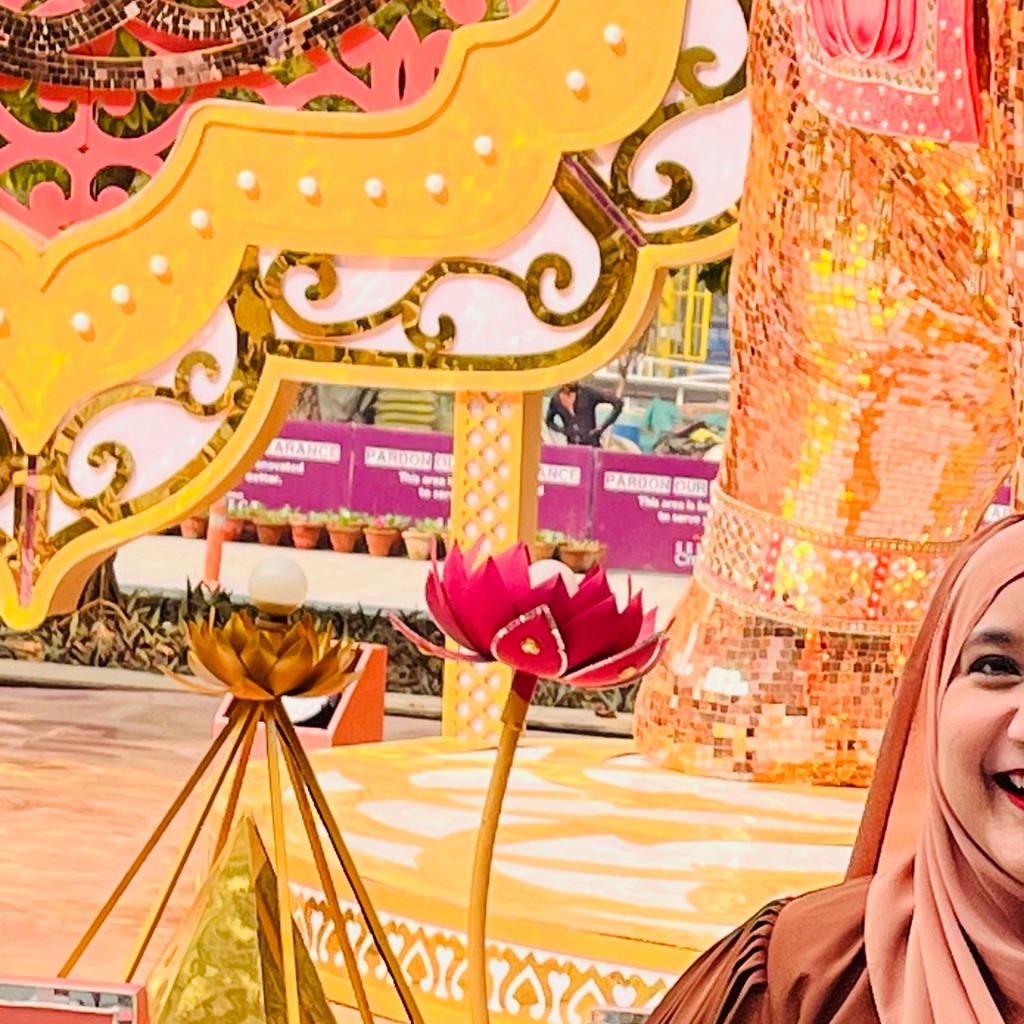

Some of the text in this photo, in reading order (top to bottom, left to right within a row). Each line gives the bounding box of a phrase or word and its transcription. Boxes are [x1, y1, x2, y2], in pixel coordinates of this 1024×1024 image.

[274, 440, 338, 458] ARANCE
[365, 450, 431, 467] PARDON
[605, 474, 706, 493] PARDON OUR
